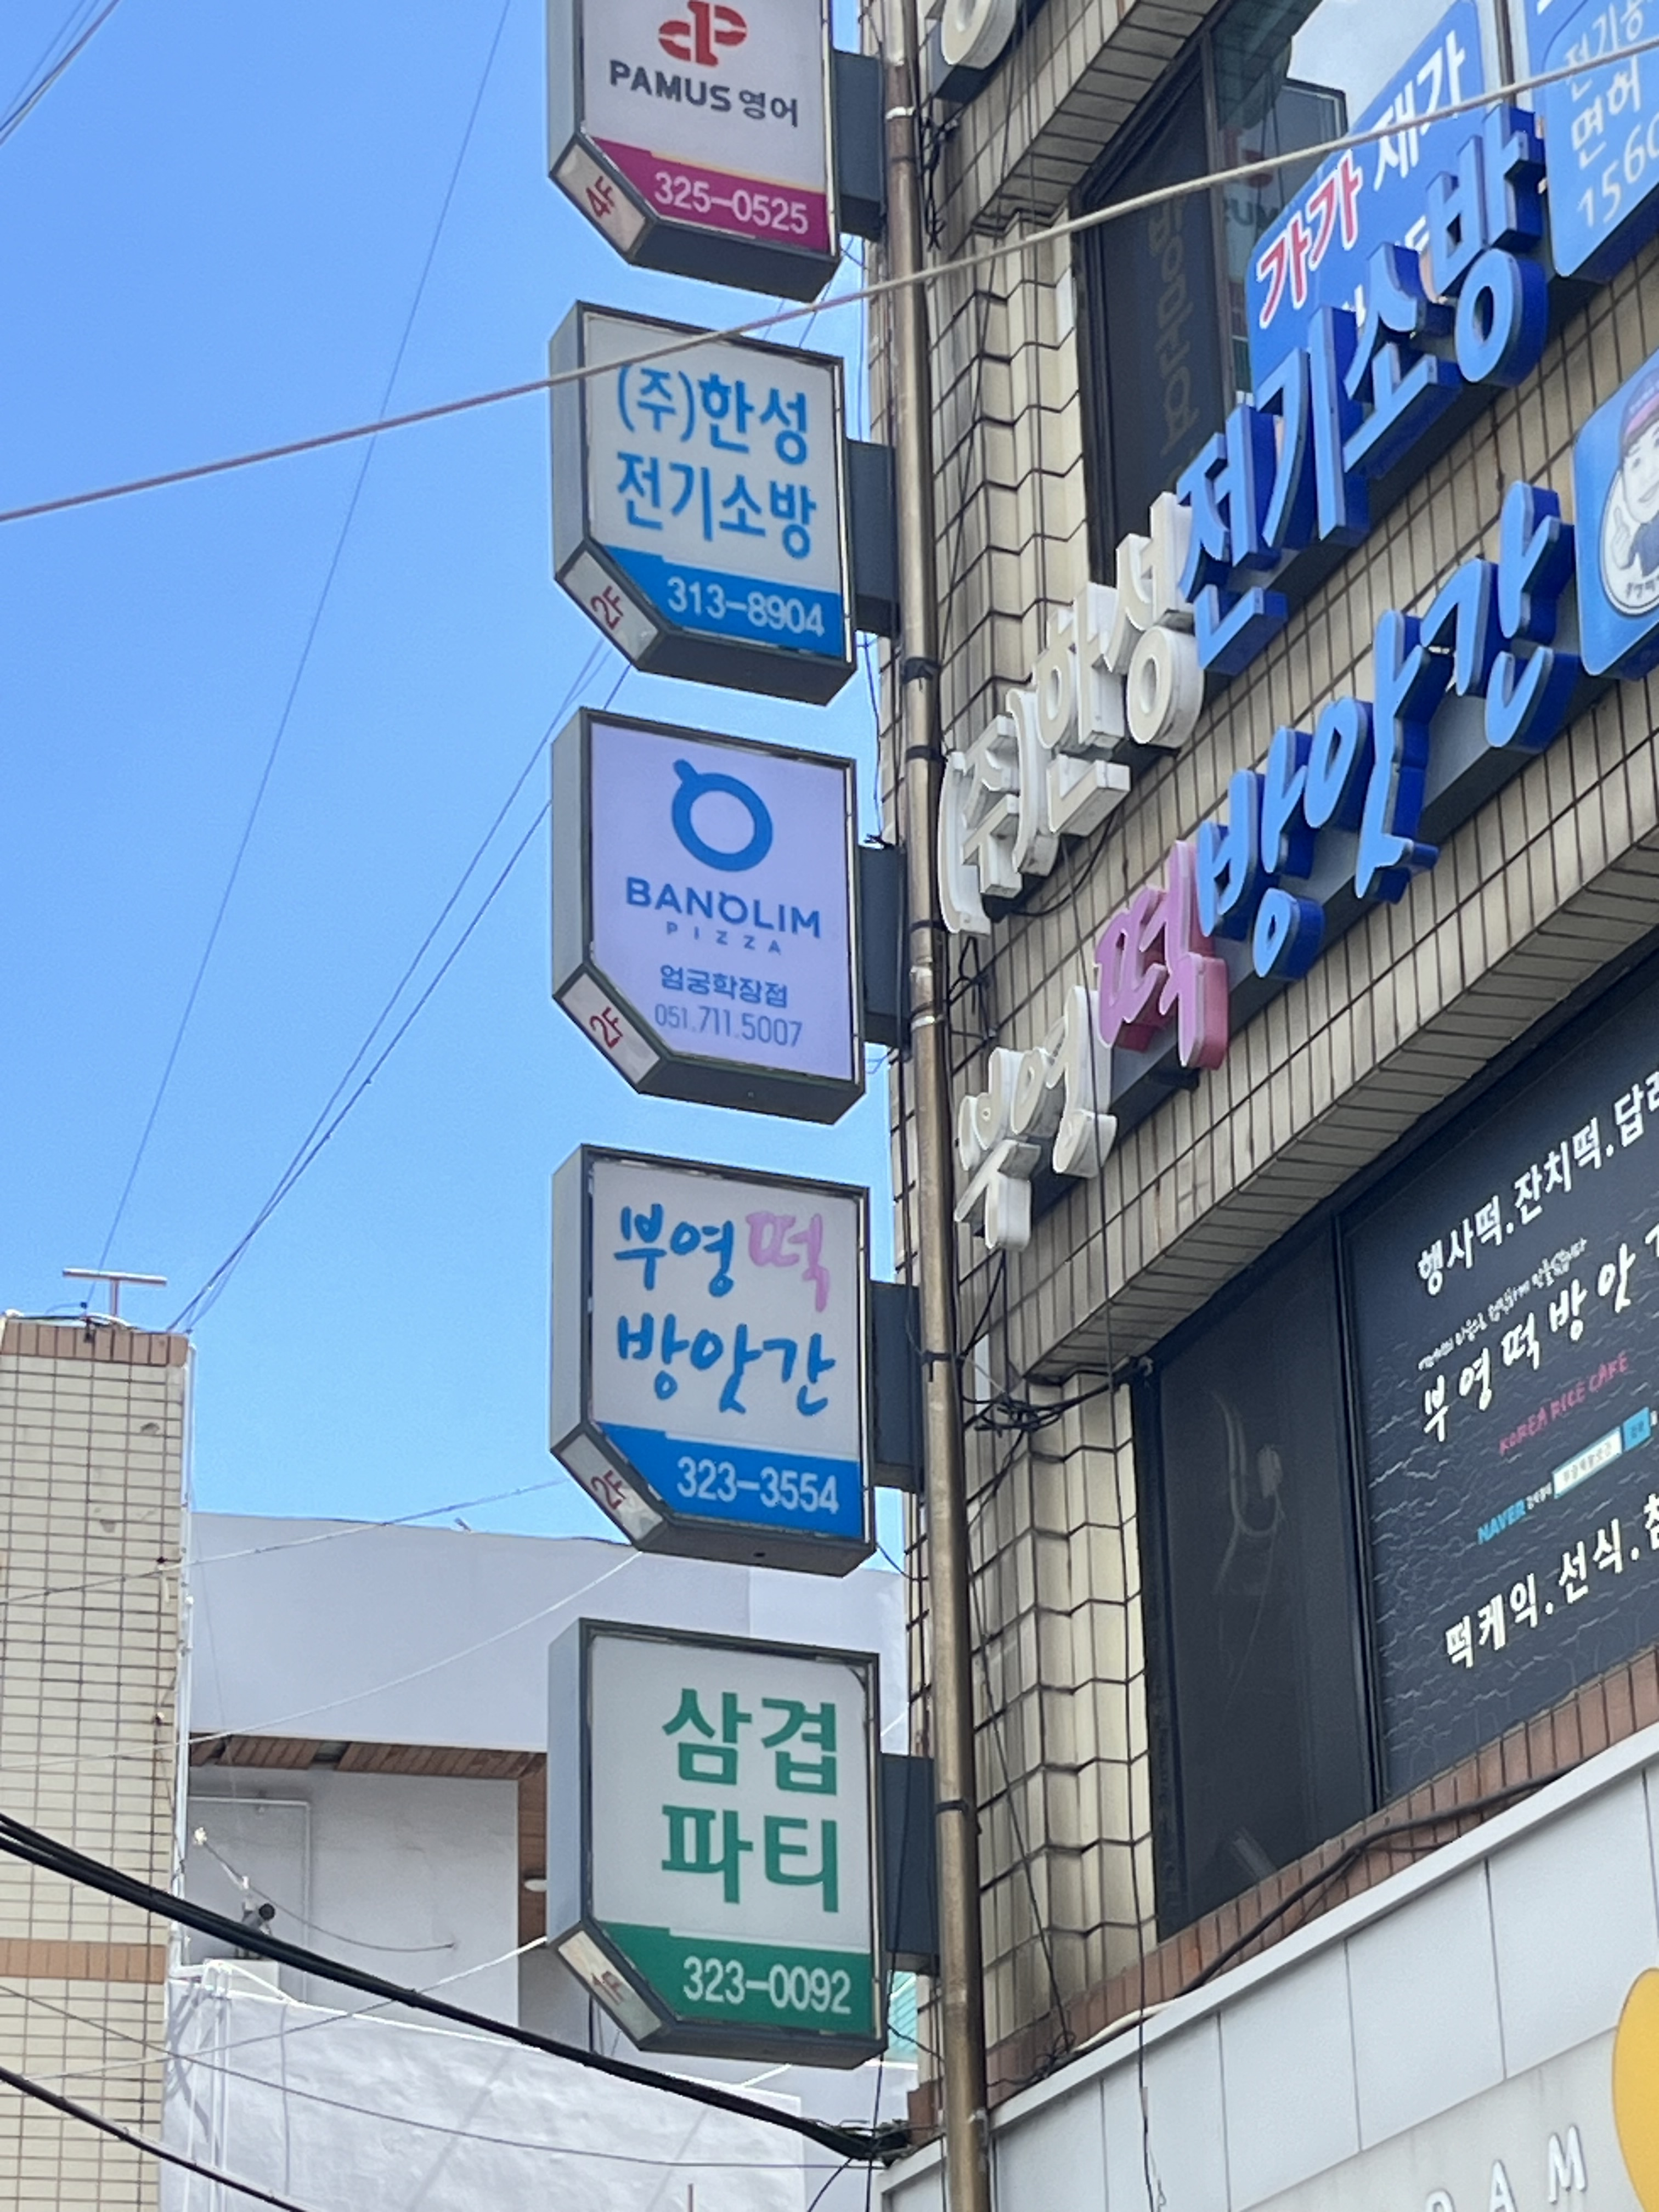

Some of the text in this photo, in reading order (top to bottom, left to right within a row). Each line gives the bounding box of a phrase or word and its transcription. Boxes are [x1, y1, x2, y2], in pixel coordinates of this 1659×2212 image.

[1571, 53, 1642, 170] 면허
[585, 176, 616, 218] 4F
[654, 172, 809, 235] 325-0525
[1256, 150, 1363, 329] 가가
[617, 364, 810, 466] (주)한성
[617, 450, 817, 560] 전기소방
[590, 585, 625, 630] 2F
[667, 577, 825, 638] 313-8904
[625, 876, 822, 939] BANOLIM
[666, 921, 782, 956] PIZZA
[589, 1006, 625, 1048] 2F
[654, 1003, 803, 1048] 051.711.5007
[617, 1312, 837, 1417] 방앗간
[590, 1469, 629, 1510] 2F
[676, 1456, 840, 1515] 323-3554
[1477, 1498, 1527, 1545] NAVER
[662, 1688, 838, 1797] 삼겹
[662, 1804, 839, 1914] 파티
[682, 1956, 852, 2016] 323-0092
